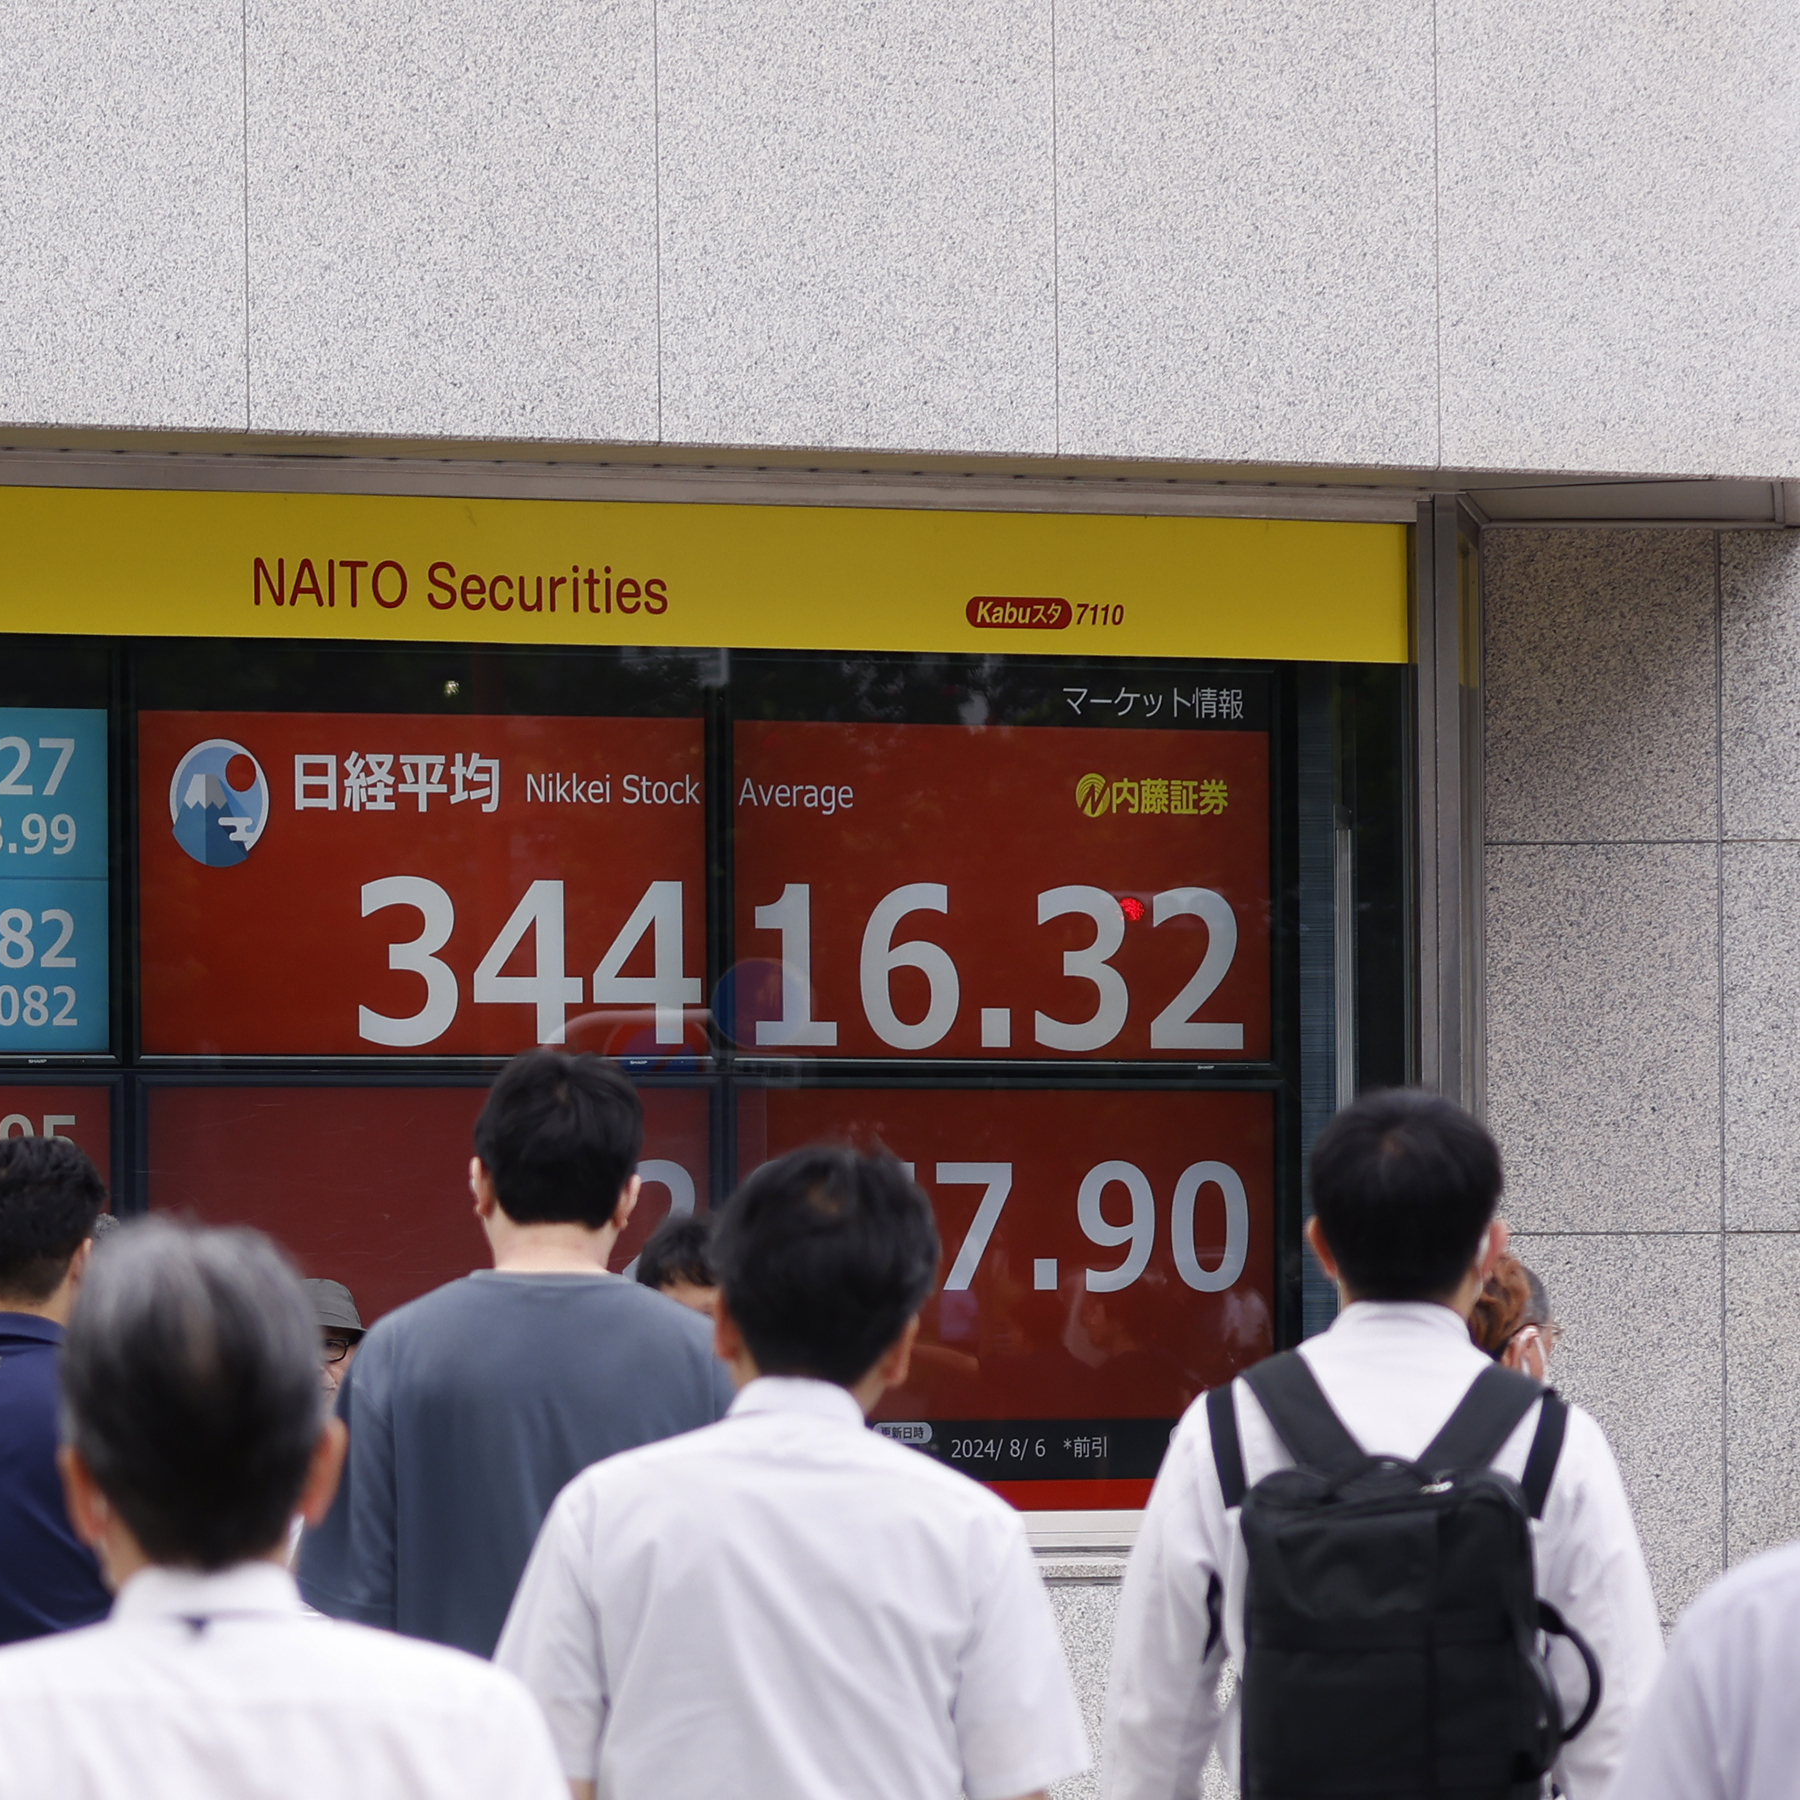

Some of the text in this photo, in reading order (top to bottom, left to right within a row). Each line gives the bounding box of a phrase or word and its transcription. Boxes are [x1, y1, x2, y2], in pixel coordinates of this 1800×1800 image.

[253, 557, 669, 614] NAITO Securities
[1076, 603, 1124, 626] 7110
[1063, 687, 1244, 719] マーケット情報
[294, 751, 854, 815] 日経平均 Nikkei Stock Average
[1112, 778, 1229, 815] 内藤証券
[951, 1438, 1004, 1461] 2024/
[1010, 1438, 1029, 1461] 8/
[1035, 1438, 1047, 1458] 6
